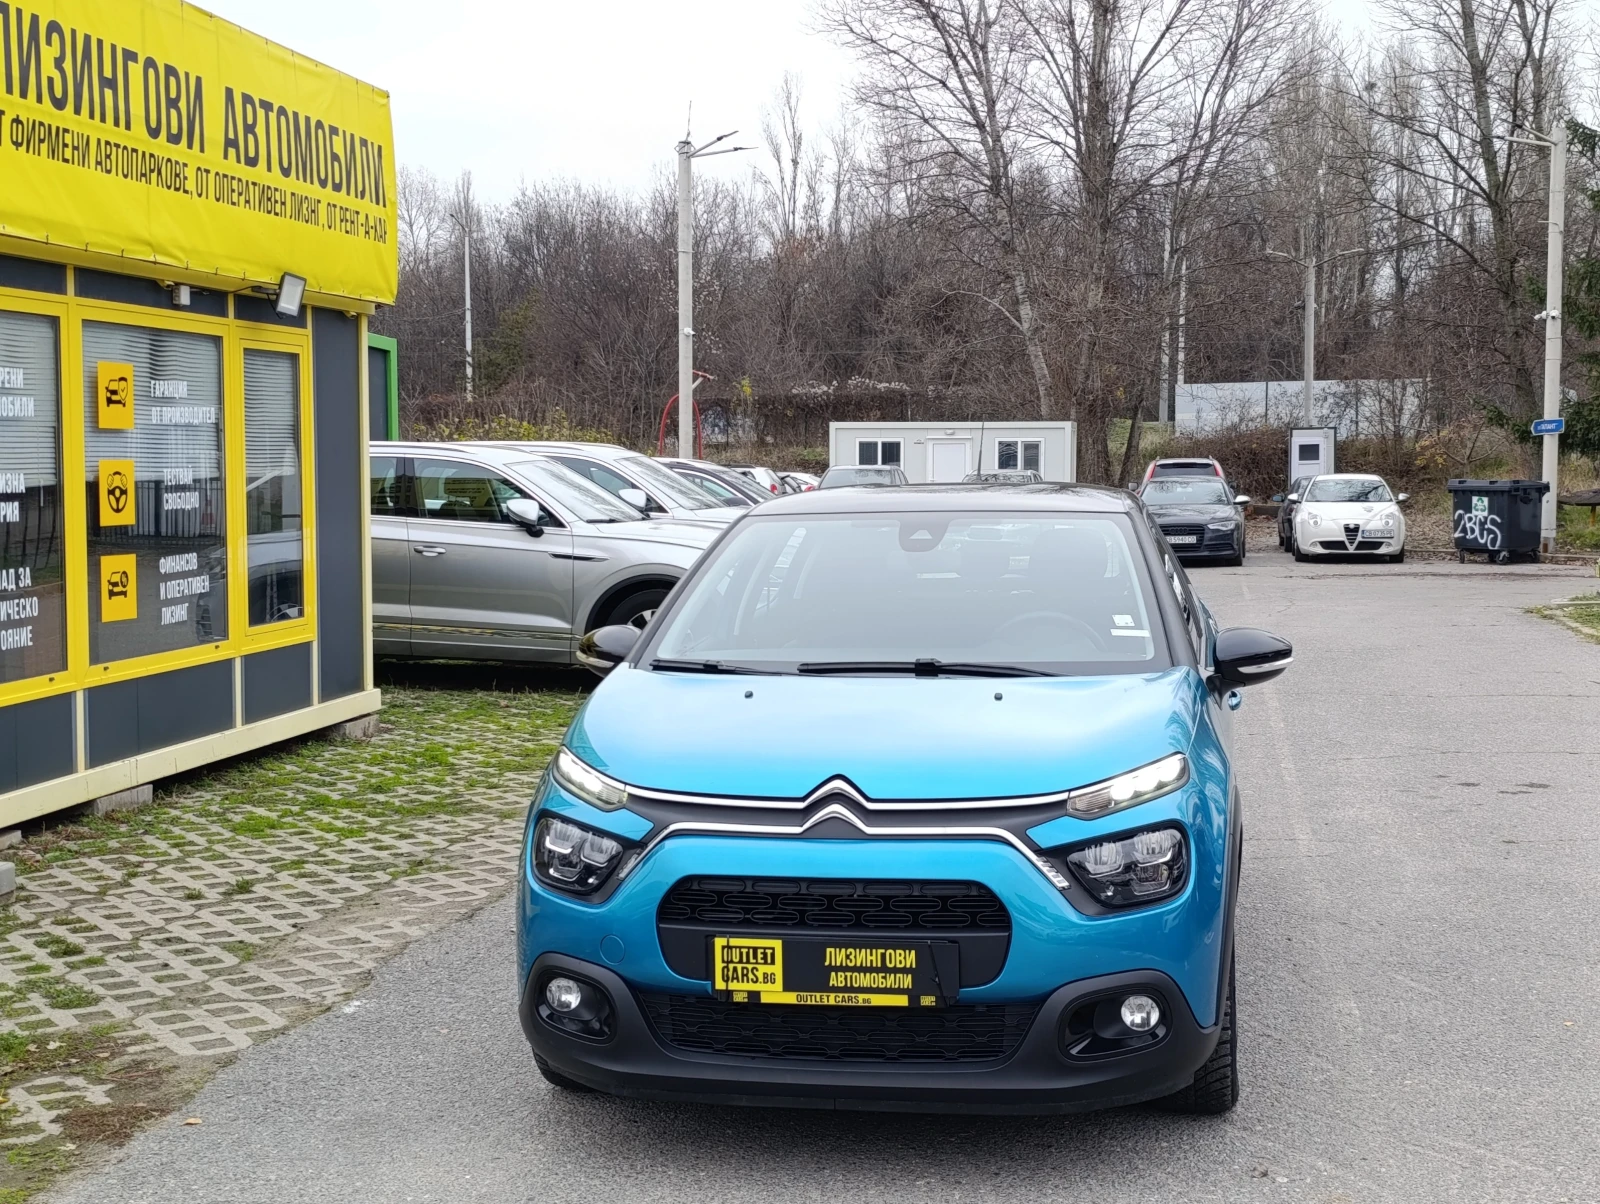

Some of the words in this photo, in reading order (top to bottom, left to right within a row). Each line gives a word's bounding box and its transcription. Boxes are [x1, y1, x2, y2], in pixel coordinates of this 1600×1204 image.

[223, 86, 386, 208] АВТОМОБИЛИ
[10, 114, 90, 169] ФИРМЕНИ
[95, 138, 192, 199] АВТОПАРКОВЕ,
[196, 166, 210, 200] ОТ
[214, 171, 286, 218] ОПЕРАТИВЕН
[327, 202, 337, 231] ОТ
[150, 380, 187, 399] ГАРАНЦИЯ
[0, 396, 34, 417] ОБИЛИ
[152, 406, 160, 424] ОТ
[162, 406, 215, 425] ПРОИЗВОДИТЕЛ
[163, 465, 193, 485] ТЕСТВАЙ
[164, 491, 199, 510] СВОБОДНО
[1, 501, 19, 522] РИЯ
[159, 552, 198, 574] ФИНАНСОВ
[0, 568, 16, 591] АД
[18, 567, 31, 587] ЗА
[160, 582, 165, 600] И
[166, 575, 209, 599] ОПЕРАТИВЕН
[161, 603, 189, 625] ЛИЗИНГ
[1, 625, 33, 650] ОЯНИЕ
[723, 948, 773, 964] OUTLET
[824, 948, 916, 968] ЛИЗИНГОВИ
[721, 966, 776, 984] CARS.BG
[829, 972, 912, 989] АВТОМОБИЛИ
[796, 993, 831, 1003] OUTLET
[834, 994, 872, 1005] CARS.BG
